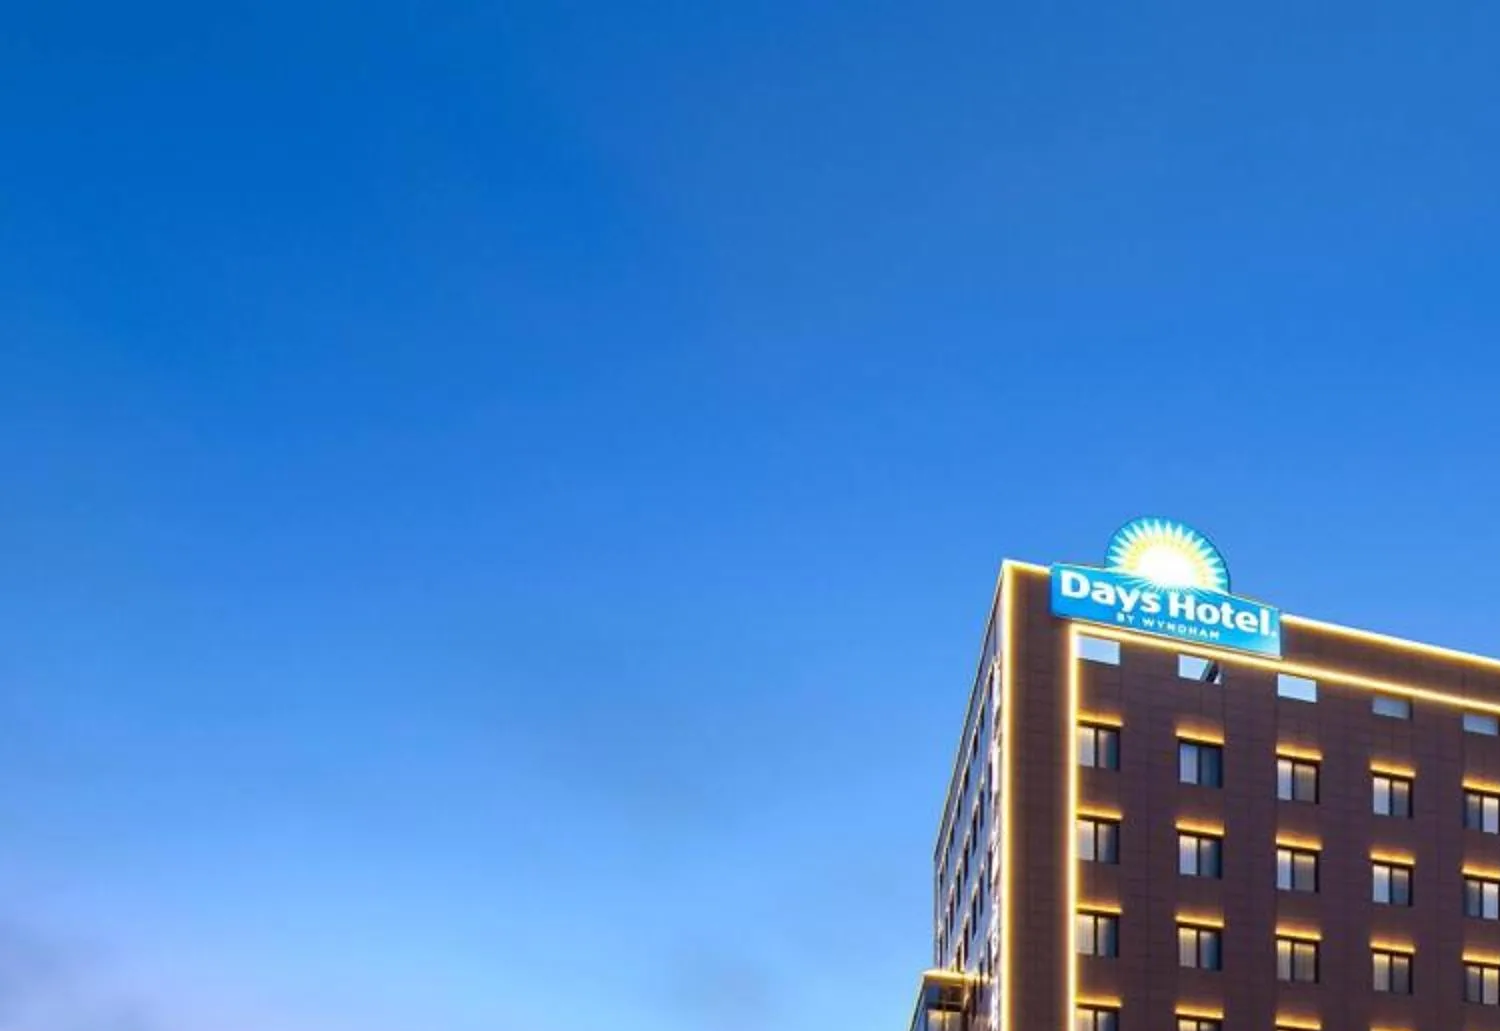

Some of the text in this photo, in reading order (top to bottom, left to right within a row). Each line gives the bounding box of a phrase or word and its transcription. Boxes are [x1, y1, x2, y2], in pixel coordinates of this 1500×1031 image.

[1060, 570, 1270, 636] Days Hotel
[1116, 613, 1221, 640] BY WYNDHAM
